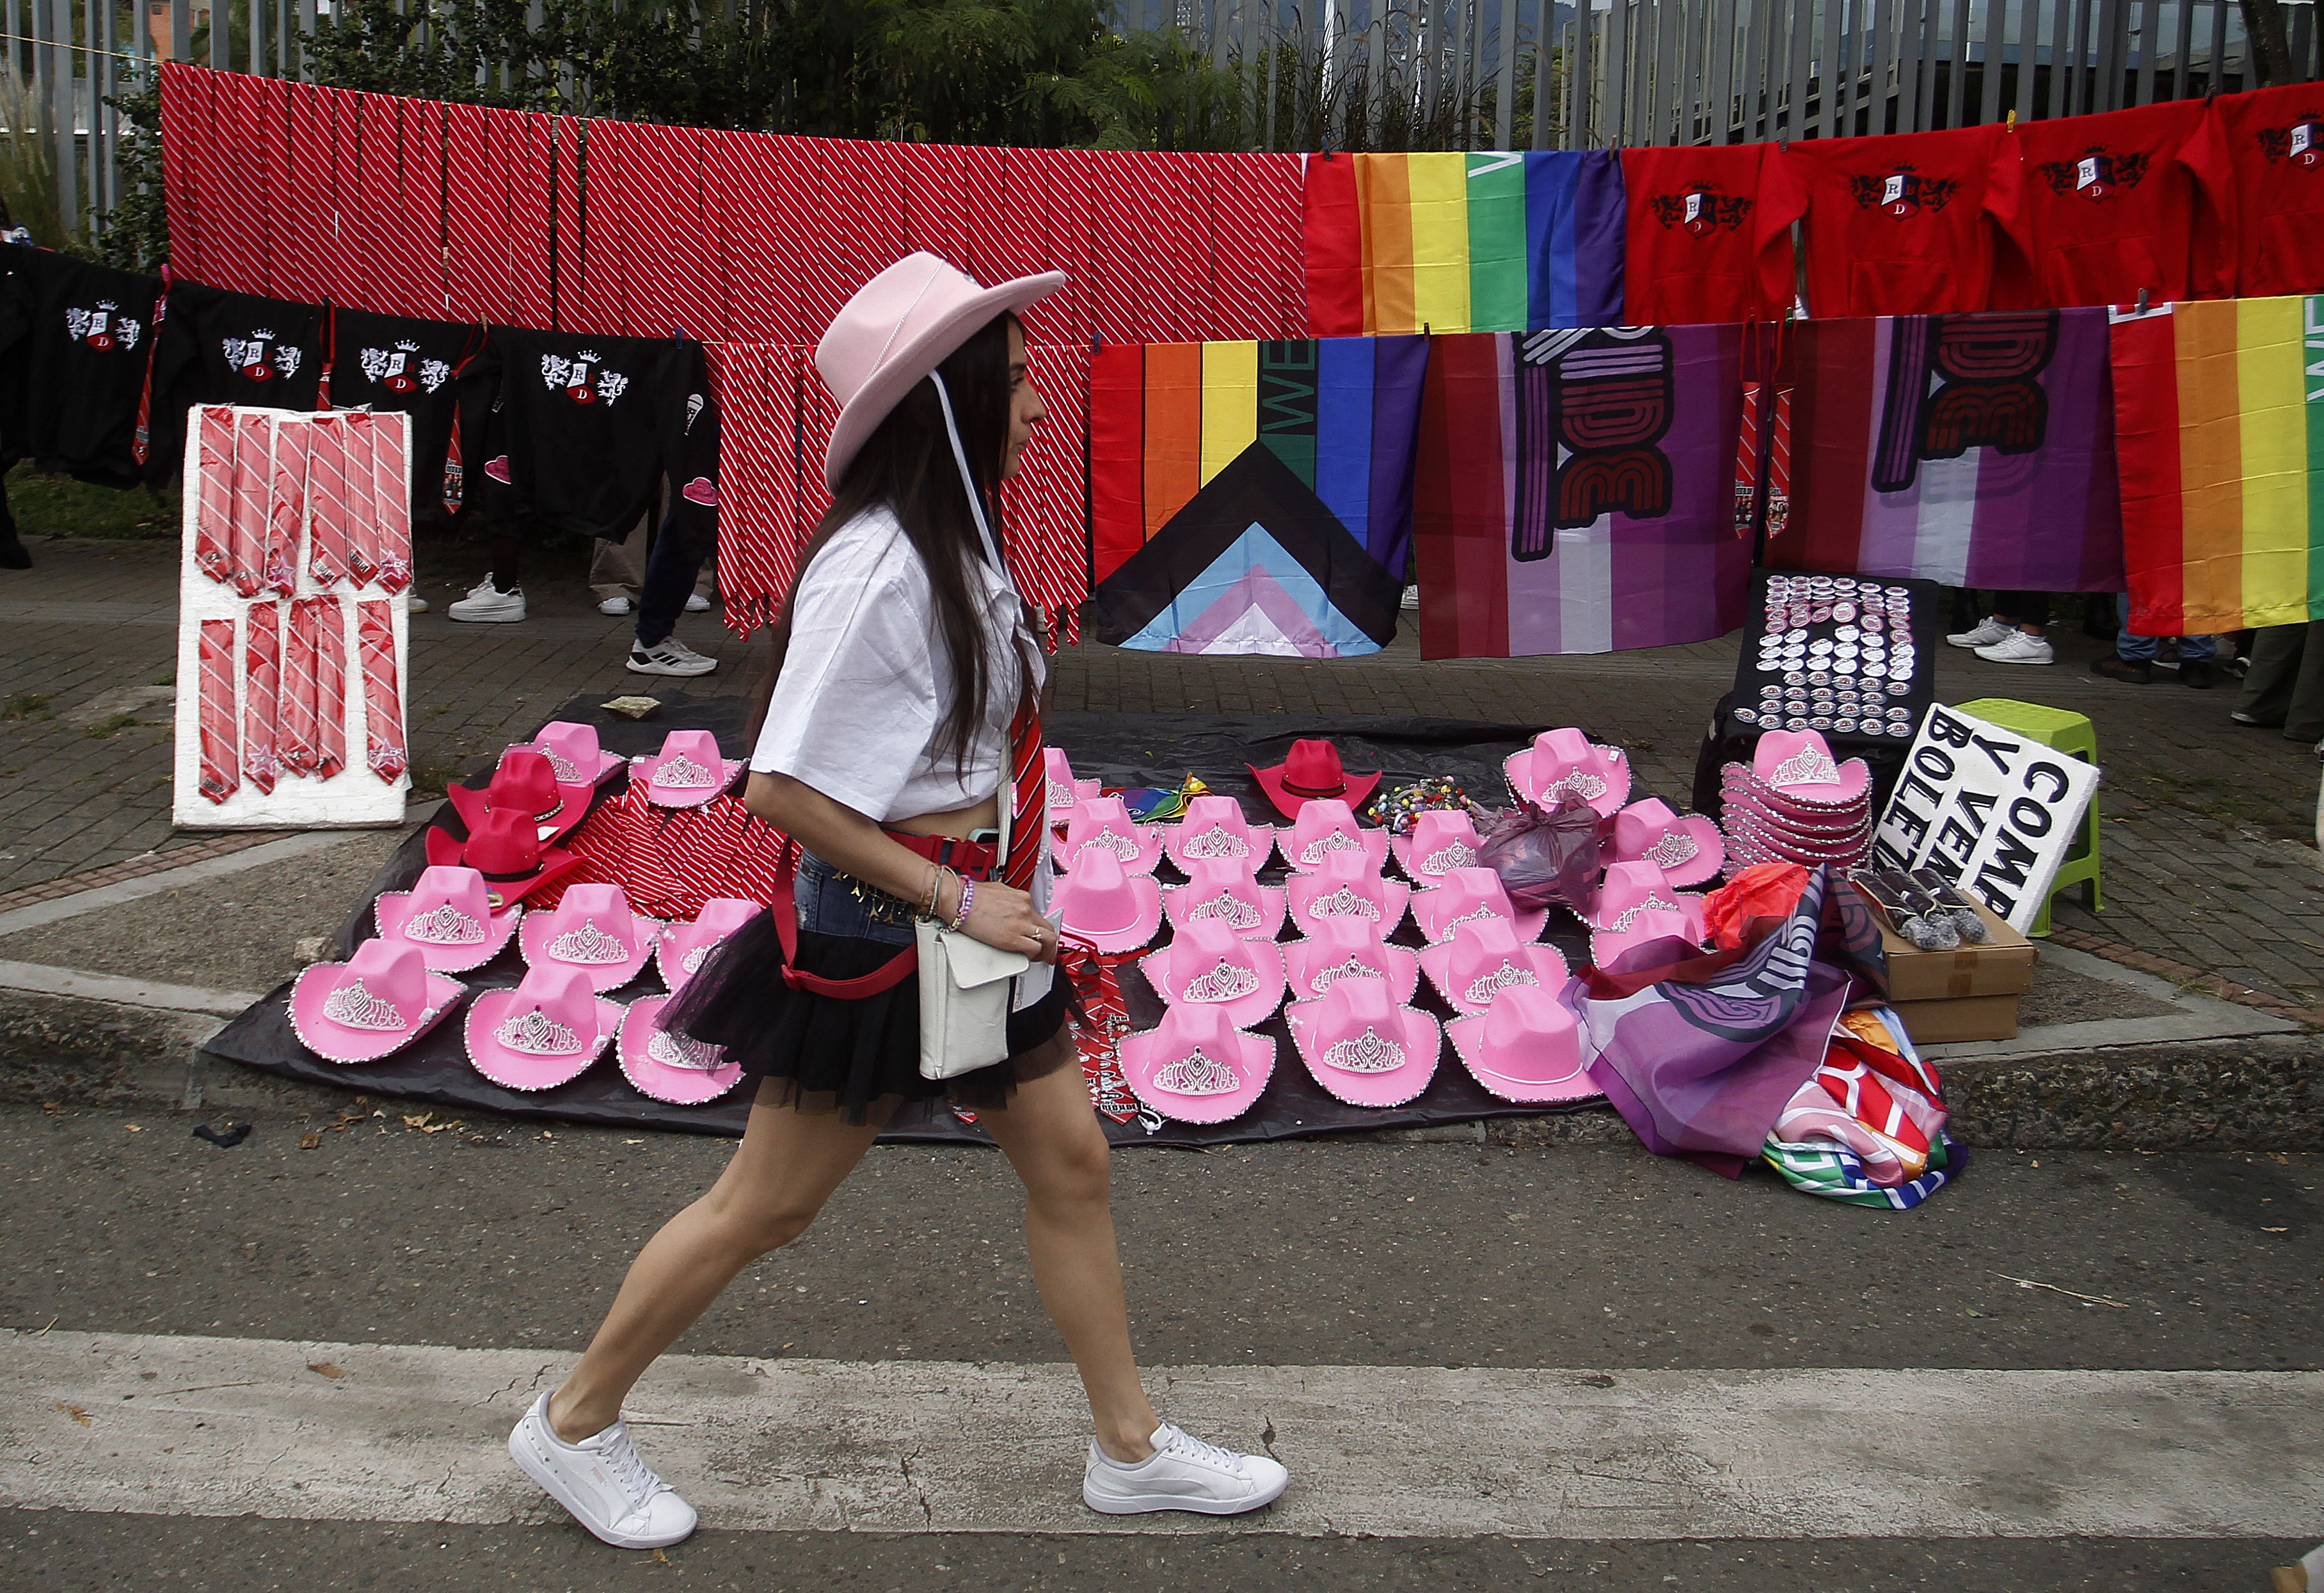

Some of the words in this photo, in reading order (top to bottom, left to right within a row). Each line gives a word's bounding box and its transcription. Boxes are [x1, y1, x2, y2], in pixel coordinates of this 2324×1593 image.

[2295, 135, 2305, 145] R
[2304, 154, 2314, 164] D
[2081, 168, 2093, 177] R
[1888, 184, 1898, 194] R
[2092, 186, 2101, 196] D
[1688, 202, 1698, 212] R
[1894, 204, 1905, 214] D
[1694, 221, 1702, 232] D
[93, 319, 103, 328] R
[98, 337, 109, 347] D
[249, 348, 259, 358] R
[392, 360, 401, 370] R
[255, 367, 266, 377] D
[575, 369, 584, 380] R
[395, 379, 406, 389] D
[577, 388, 587, 399] D
[1971, 734, 2020, 775] Y
